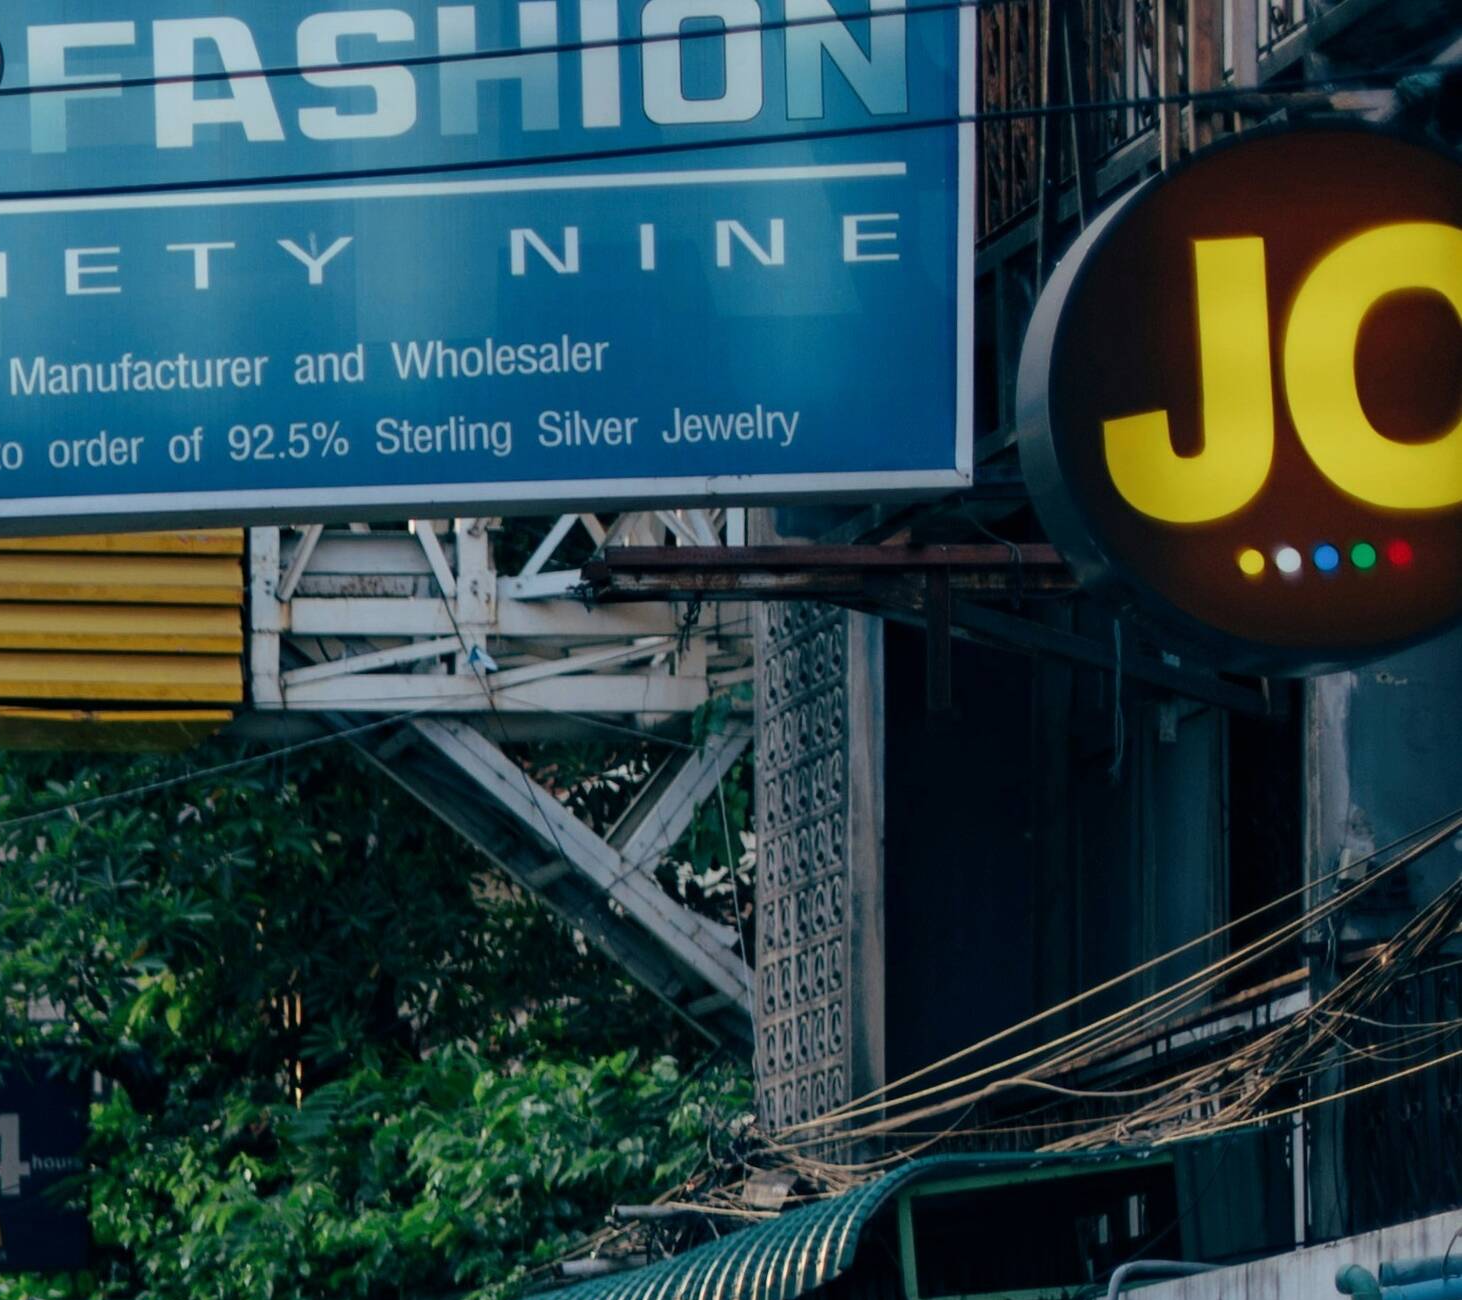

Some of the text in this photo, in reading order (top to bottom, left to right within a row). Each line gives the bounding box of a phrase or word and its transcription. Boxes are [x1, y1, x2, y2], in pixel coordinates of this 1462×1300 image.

[510, 213, 901, 276] NINE
[9, 334, 610, 396] Manufacturer and Wholesaler
[47, 430, 144, 469] order
[167, 426, 204, 464] of
[227, 421, 350, 462] 92.5%
[374, 413, 513, 458] Sterling
[538, 409, 639, 448] Silver
[661, 403, 800, 447] Jewelry
